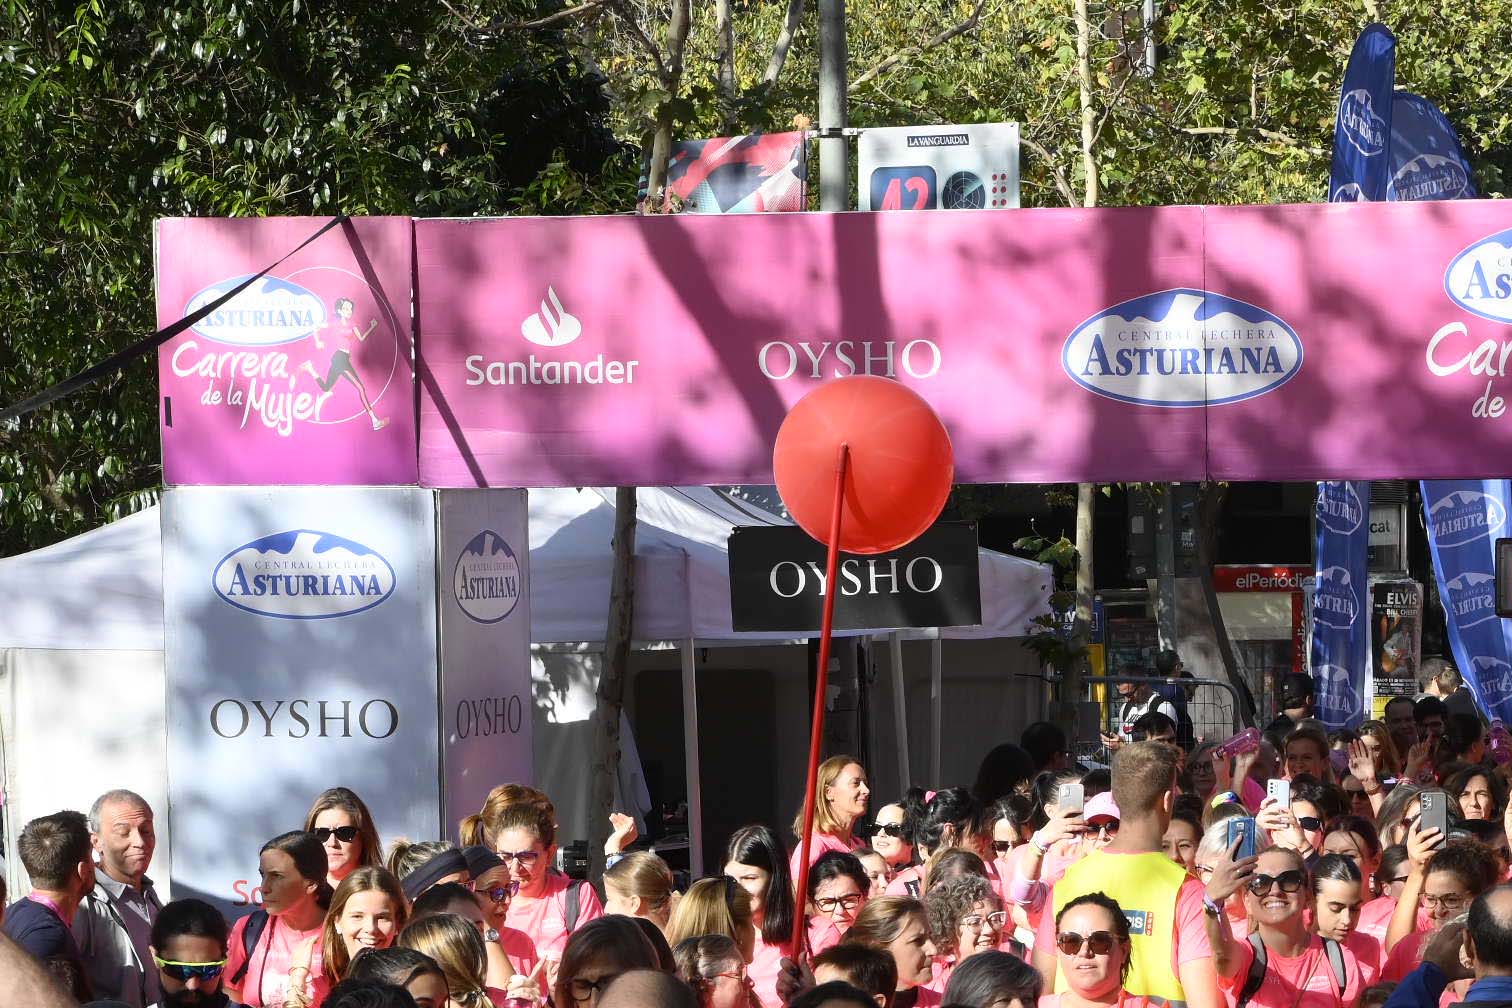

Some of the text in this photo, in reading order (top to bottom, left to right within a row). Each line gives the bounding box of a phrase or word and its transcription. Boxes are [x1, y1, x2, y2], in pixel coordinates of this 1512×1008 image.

[1082, 332, 1285, 378] ASTURIANA
[1118, 329, 1277, 342] CENTRAL LECHERA
[171, 340, 290, 379] Carrera
[465, 353, 640, 387] Santander
[758, 338, 942, 379] OYSHO
[201, 376, 334, 437] de la Mujer
[1471, 379, 1507, 419] de
[227, 562, 383, 597] ASTURIANA
[458, 565, 517, 601] ASTURIANA
[769, 556, 943, 598] OYSHO
[1386, 592, 1417, 605] ELVIS
[209, 698, 399, 739] OYSHO
[455, 695, 522, 739] OYSHO
